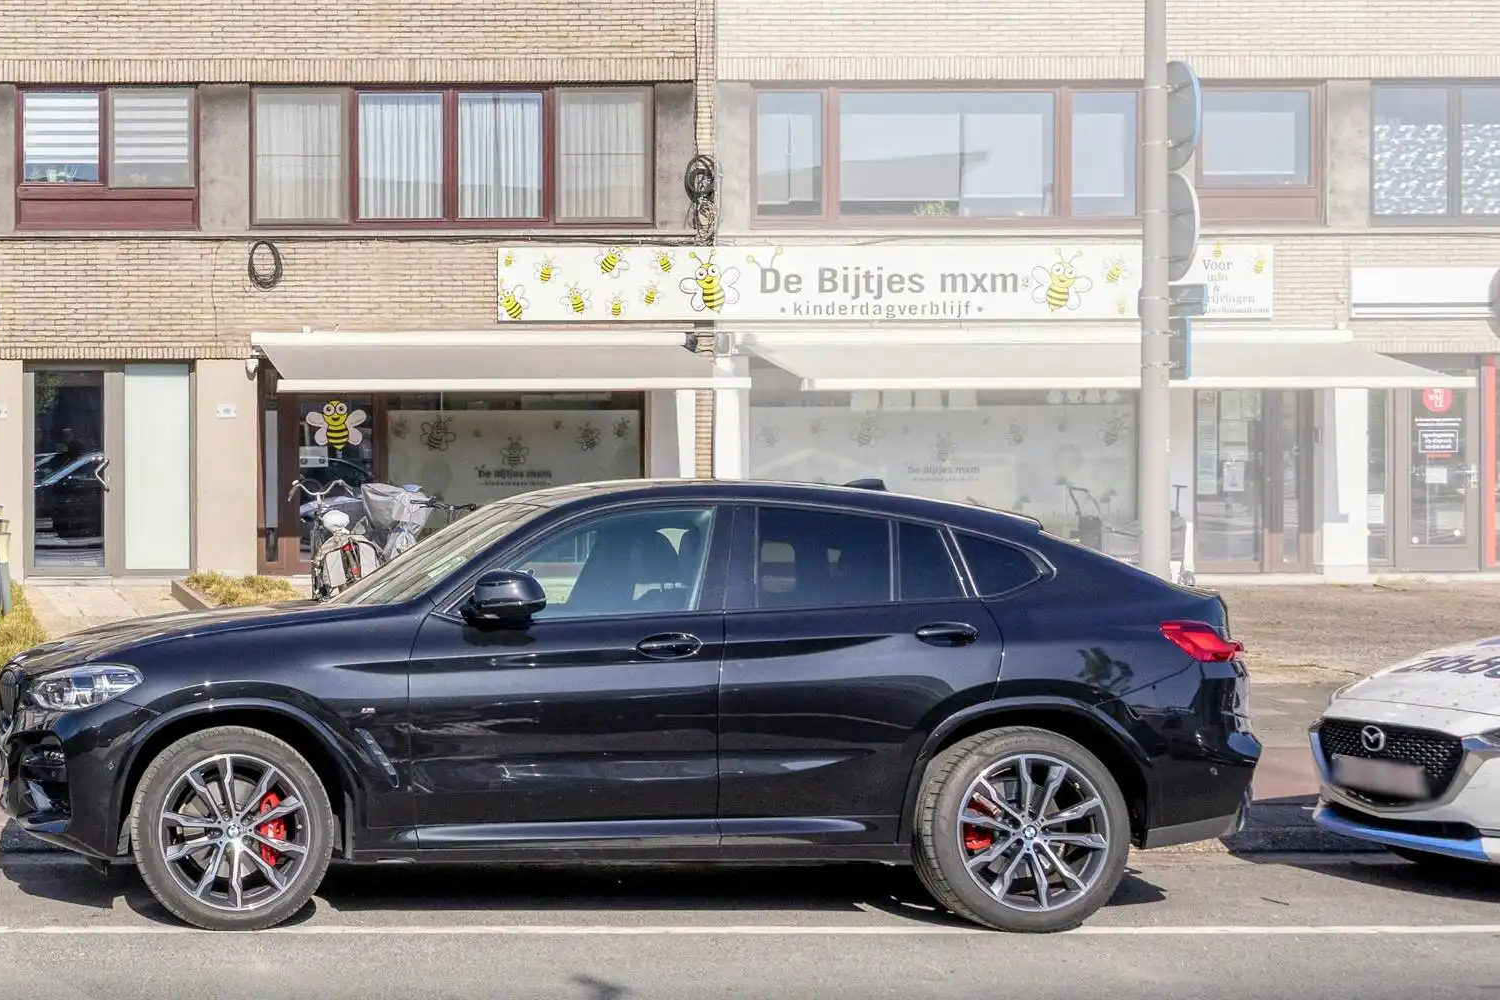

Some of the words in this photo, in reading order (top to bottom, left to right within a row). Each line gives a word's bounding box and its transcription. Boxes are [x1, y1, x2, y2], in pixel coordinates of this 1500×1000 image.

[1203, 259, 1233, 270] Voor
[760, 267, 802, 294] De
[818, 266, 925, 300] Bijtjes
[1207, 293, 1255, 304] rijvingen
[793, 301, 971, 318] kinderdagverblijf
